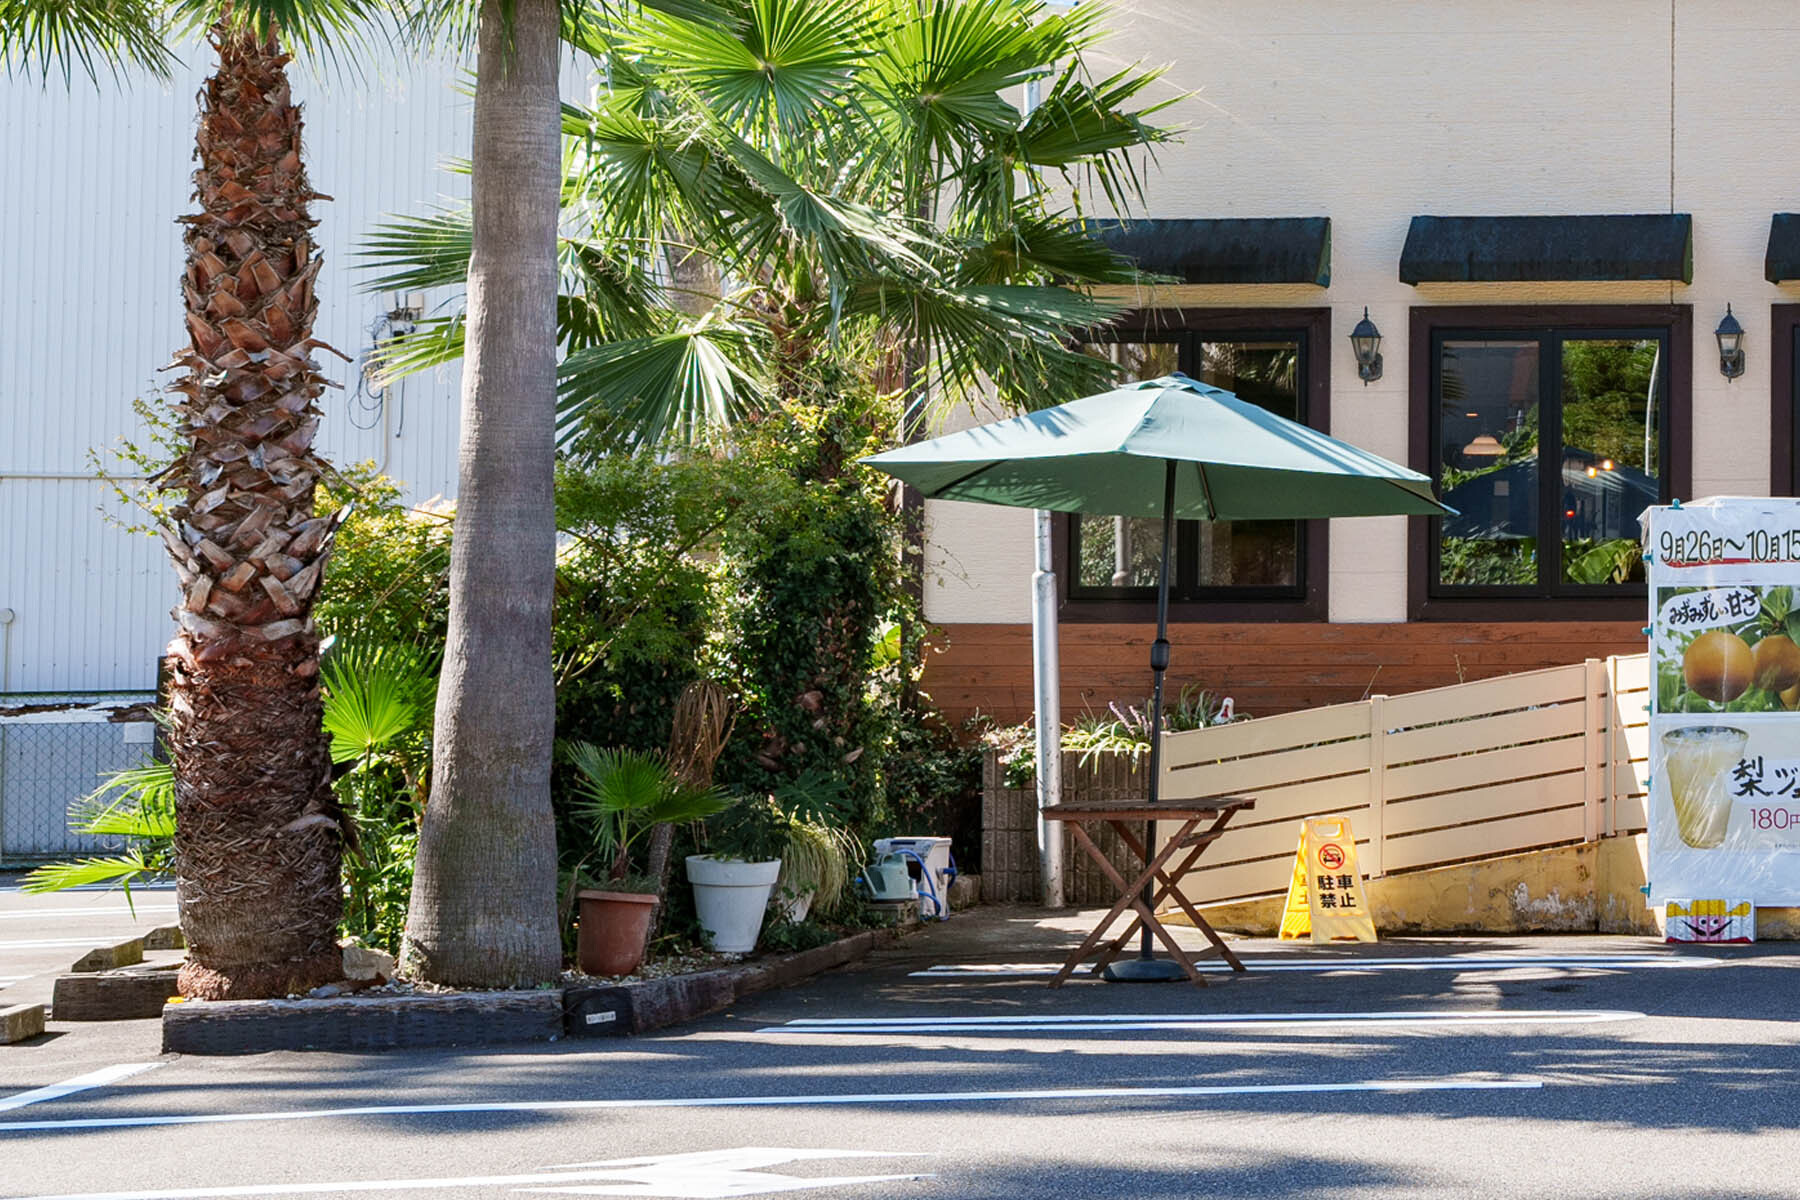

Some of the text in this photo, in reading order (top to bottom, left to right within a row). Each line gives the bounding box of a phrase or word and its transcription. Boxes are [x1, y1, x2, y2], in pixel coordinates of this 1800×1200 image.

[1669, 590, 1760, 626] みずみずしい甘さ
[1317, 874, 1354, 890] 駐車
[1319, 892, 1357, 909] 禁止
